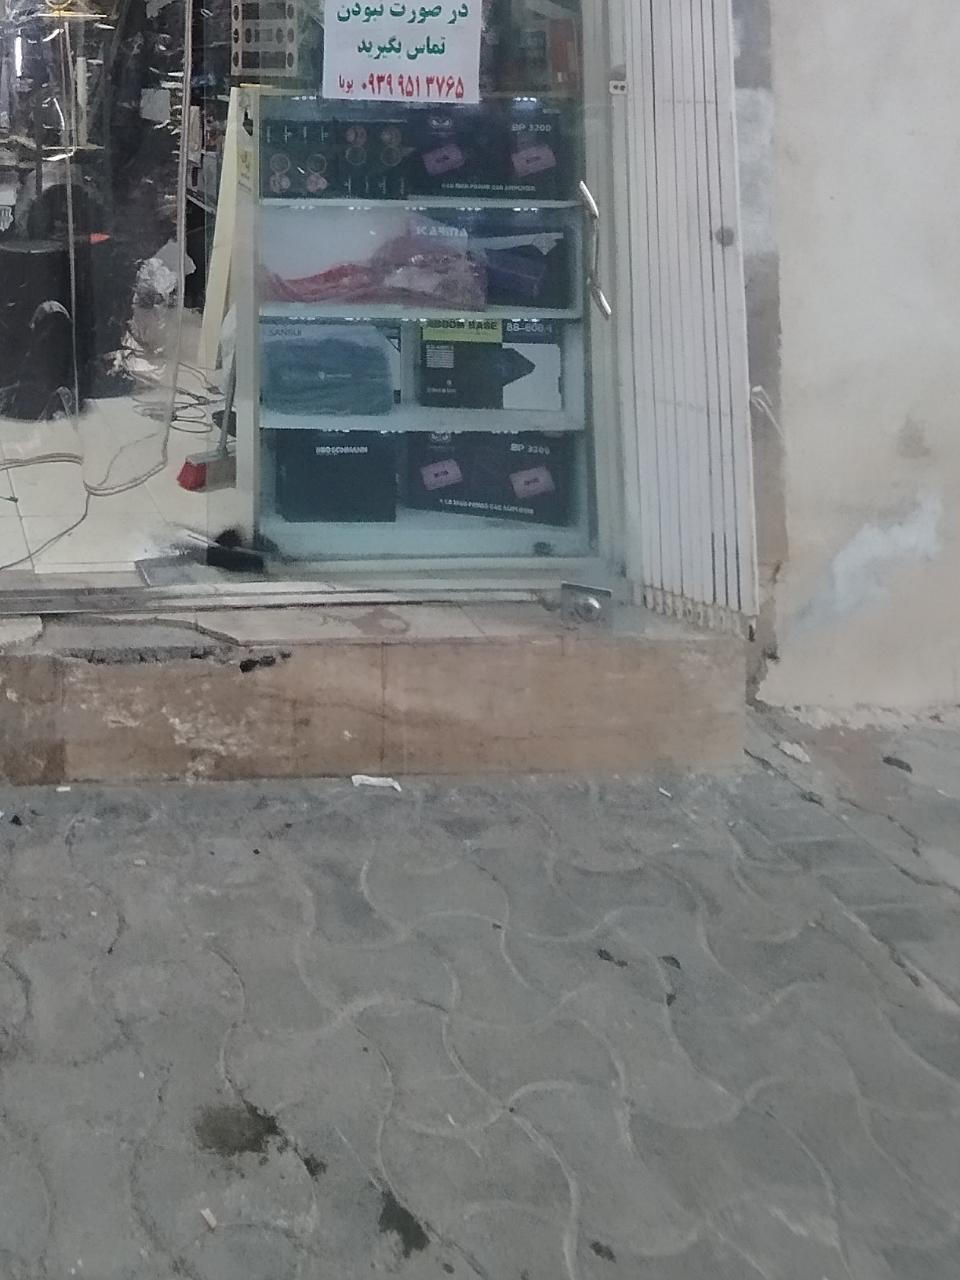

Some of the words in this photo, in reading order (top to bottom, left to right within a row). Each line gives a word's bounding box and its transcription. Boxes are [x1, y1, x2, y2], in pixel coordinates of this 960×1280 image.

[389, 2, 442, 24] صورت
[447, 3, 469, 24] در
[357, 36, 402, 60] بگیرید
[406, 36, 446, 60] تماس
